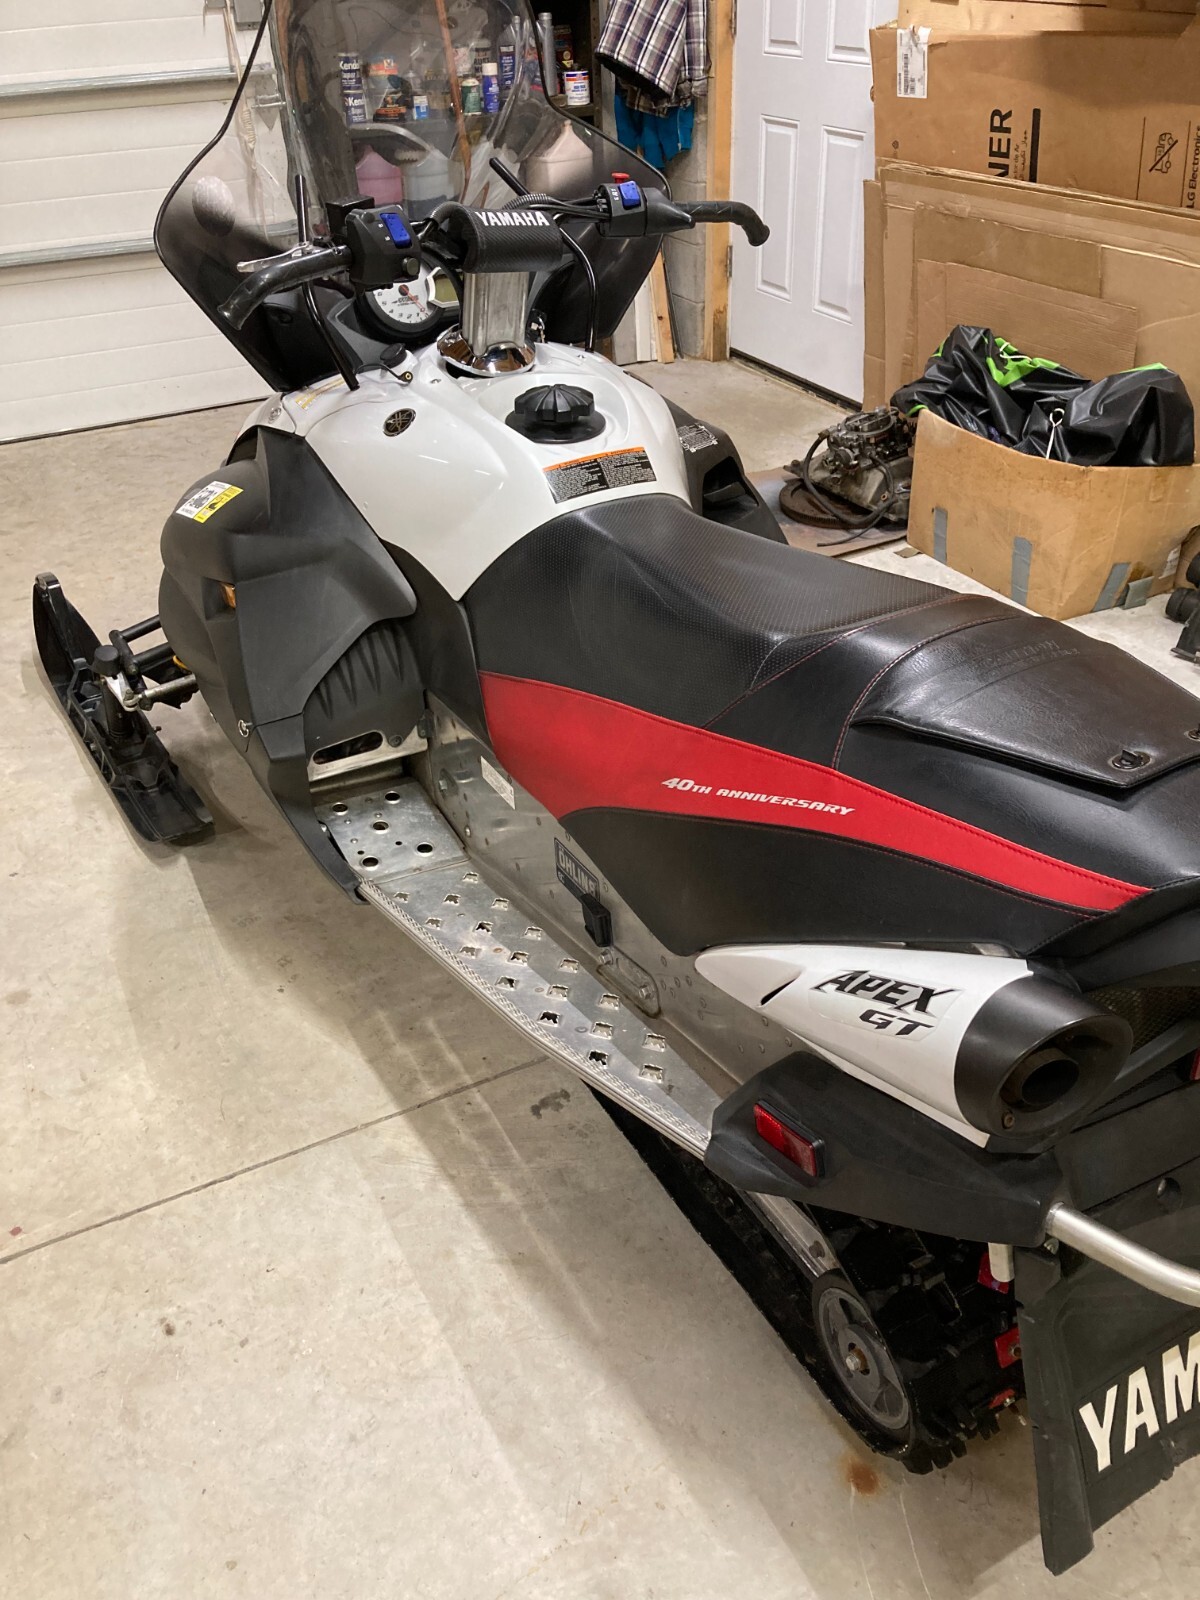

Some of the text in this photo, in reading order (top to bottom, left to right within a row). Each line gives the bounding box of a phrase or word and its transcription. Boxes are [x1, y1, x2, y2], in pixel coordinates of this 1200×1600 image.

[988, 108, 1013, 178] NER
[475, 211, 550, 226] YAMAHA
[1186, 191, 1196, 209] LG
[661, 777, 856, 816] 40TH ANNIVERSARY
[810, 969, 961, 1016] APEX
[859, 1008, 935, 1036] GT
[1078, 1331, 1200, 1473] YAM
